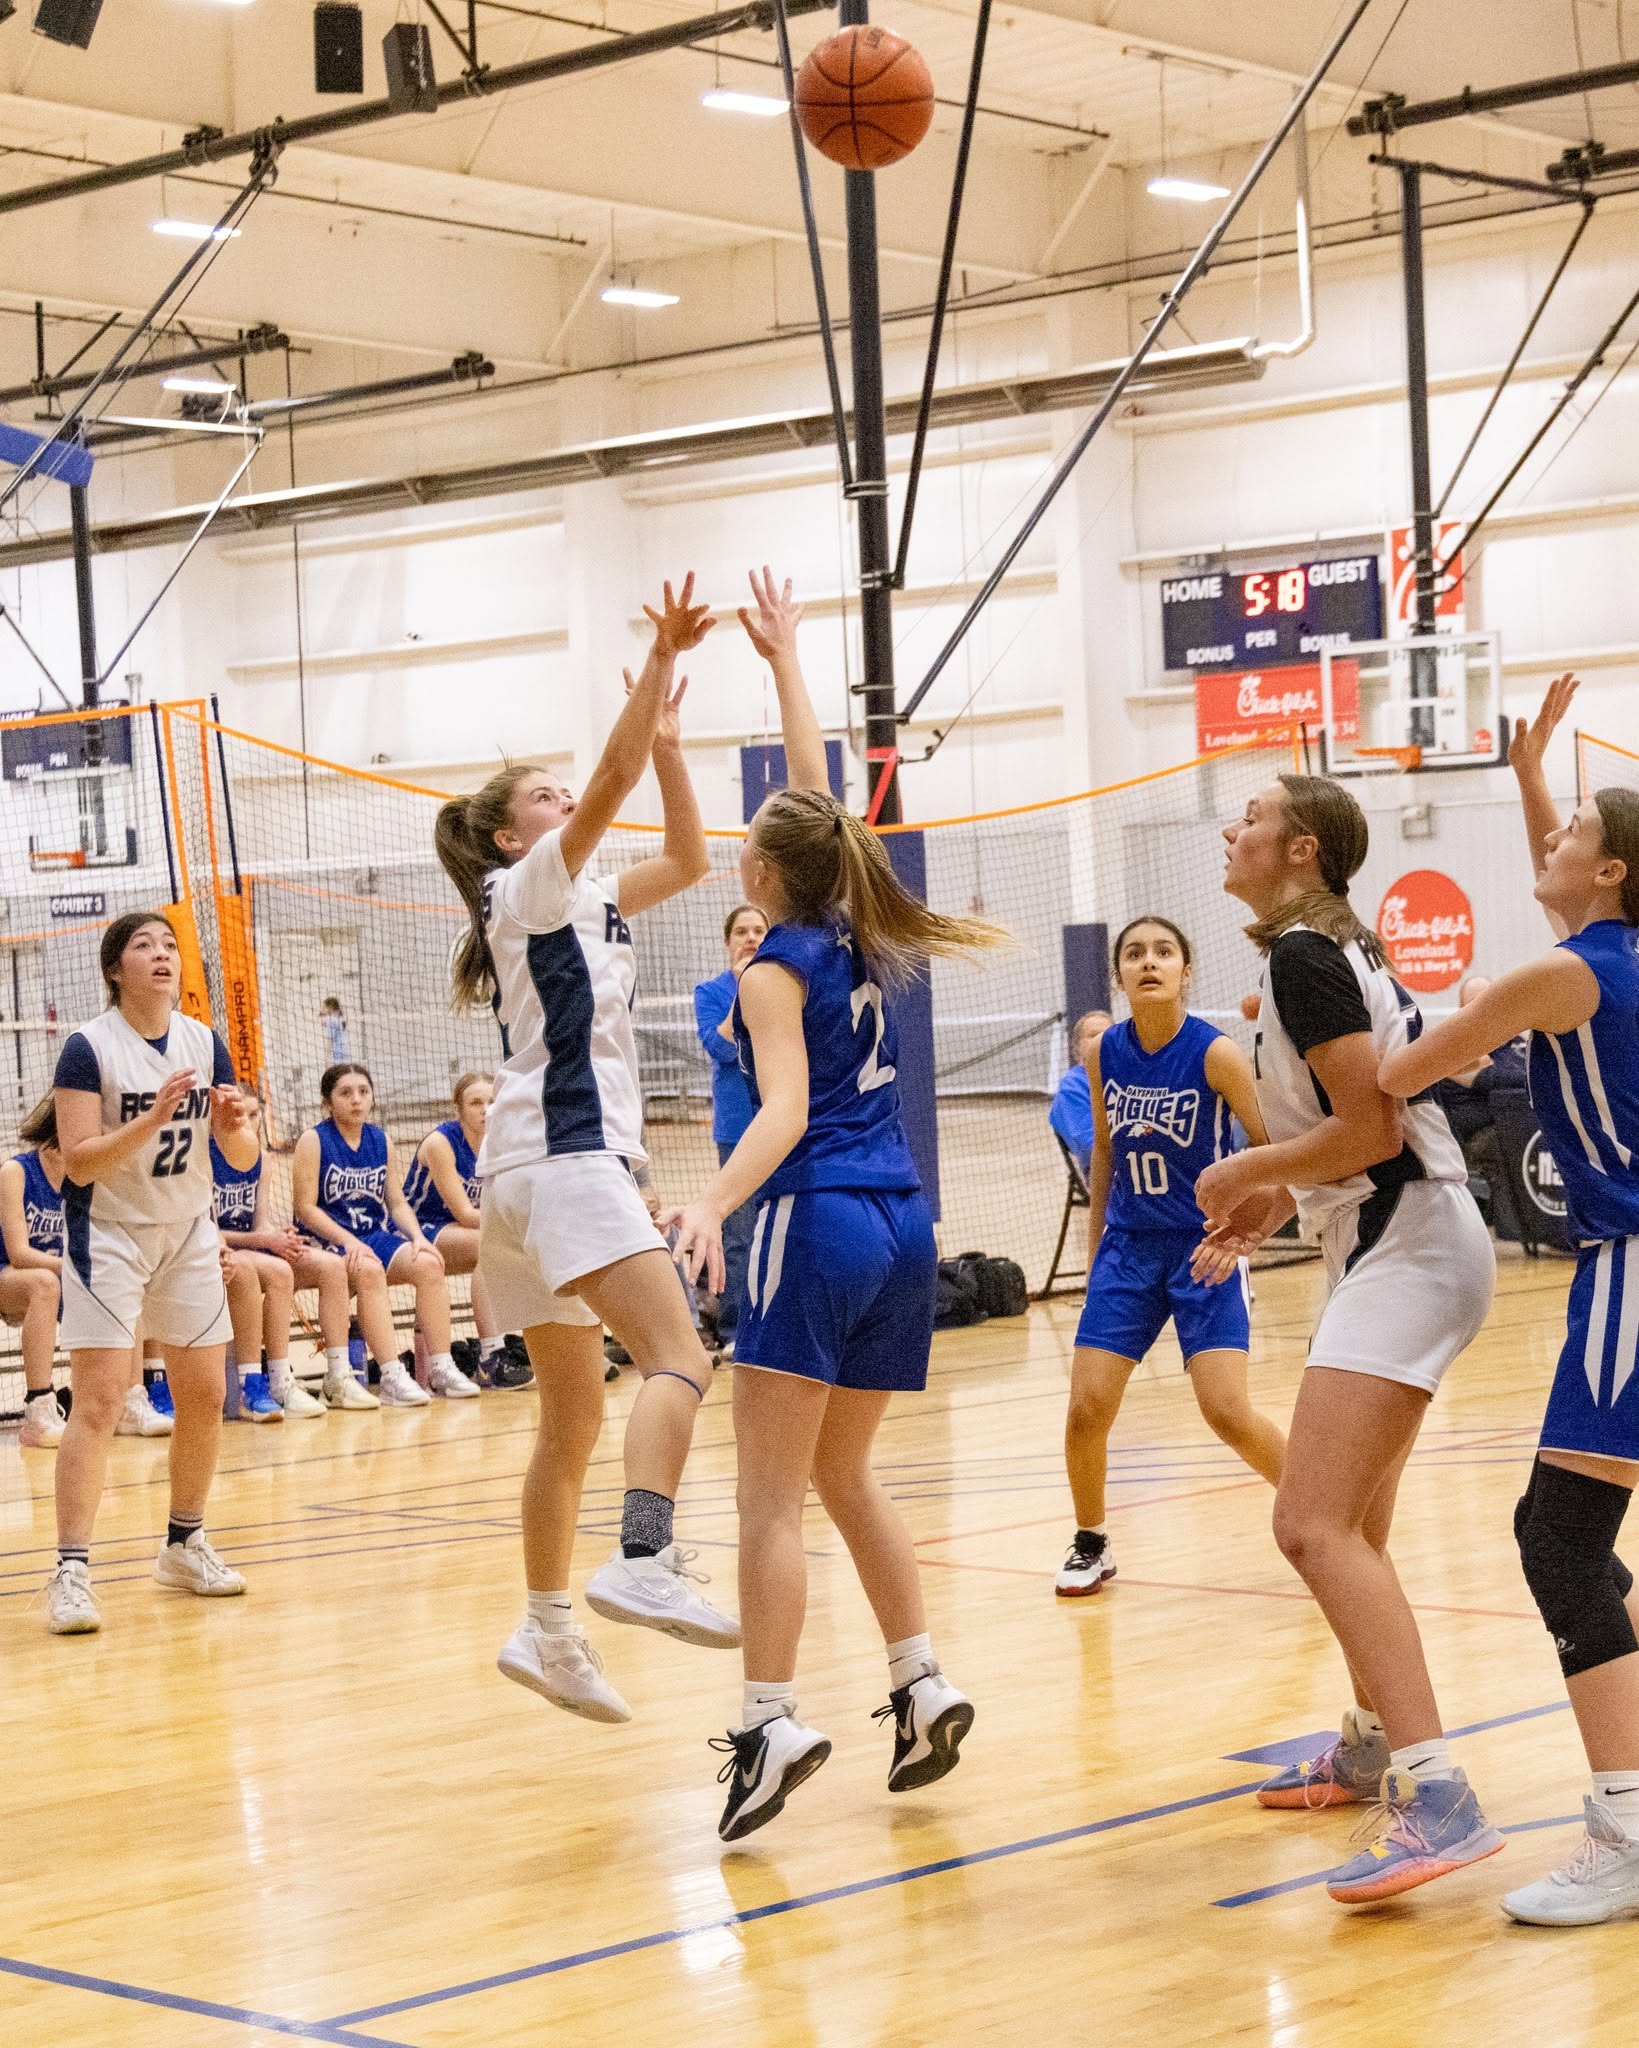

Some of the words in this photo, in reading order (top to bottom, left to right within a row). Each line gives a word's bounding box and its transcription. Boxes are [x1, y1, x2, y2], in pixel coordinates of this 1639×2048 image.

[1163, 576, 1223, 603] HOME
[1244, 570, 1306, 617] 5:18
[1307, 559, 1371, 587] GUEST
[1186, 645, 1234, 664] BONUS
[1245, 629, 1277, 648] PER
[1300, 632, 1350, 653] BONUS
[51, 896, 94, 914] COURT
[1394, 941, 1456, 960] Loveland
[233, 980, 252, 1072] CHAMPRO
[851, 981, 896, 1096] 2
[120, 1088, 210, 1123] ASENT
[1126, 1085, 1168, 1098] DAYSPRING
[1103, 1079, 1199, 1147] EAGLES
[152, 1127, 192, 1177] 22
[324, 1164, 386, 1204] EAGLES
[1126, 1152, 1169, 1195] 10
[348, 1207, 373, 1230] 15
